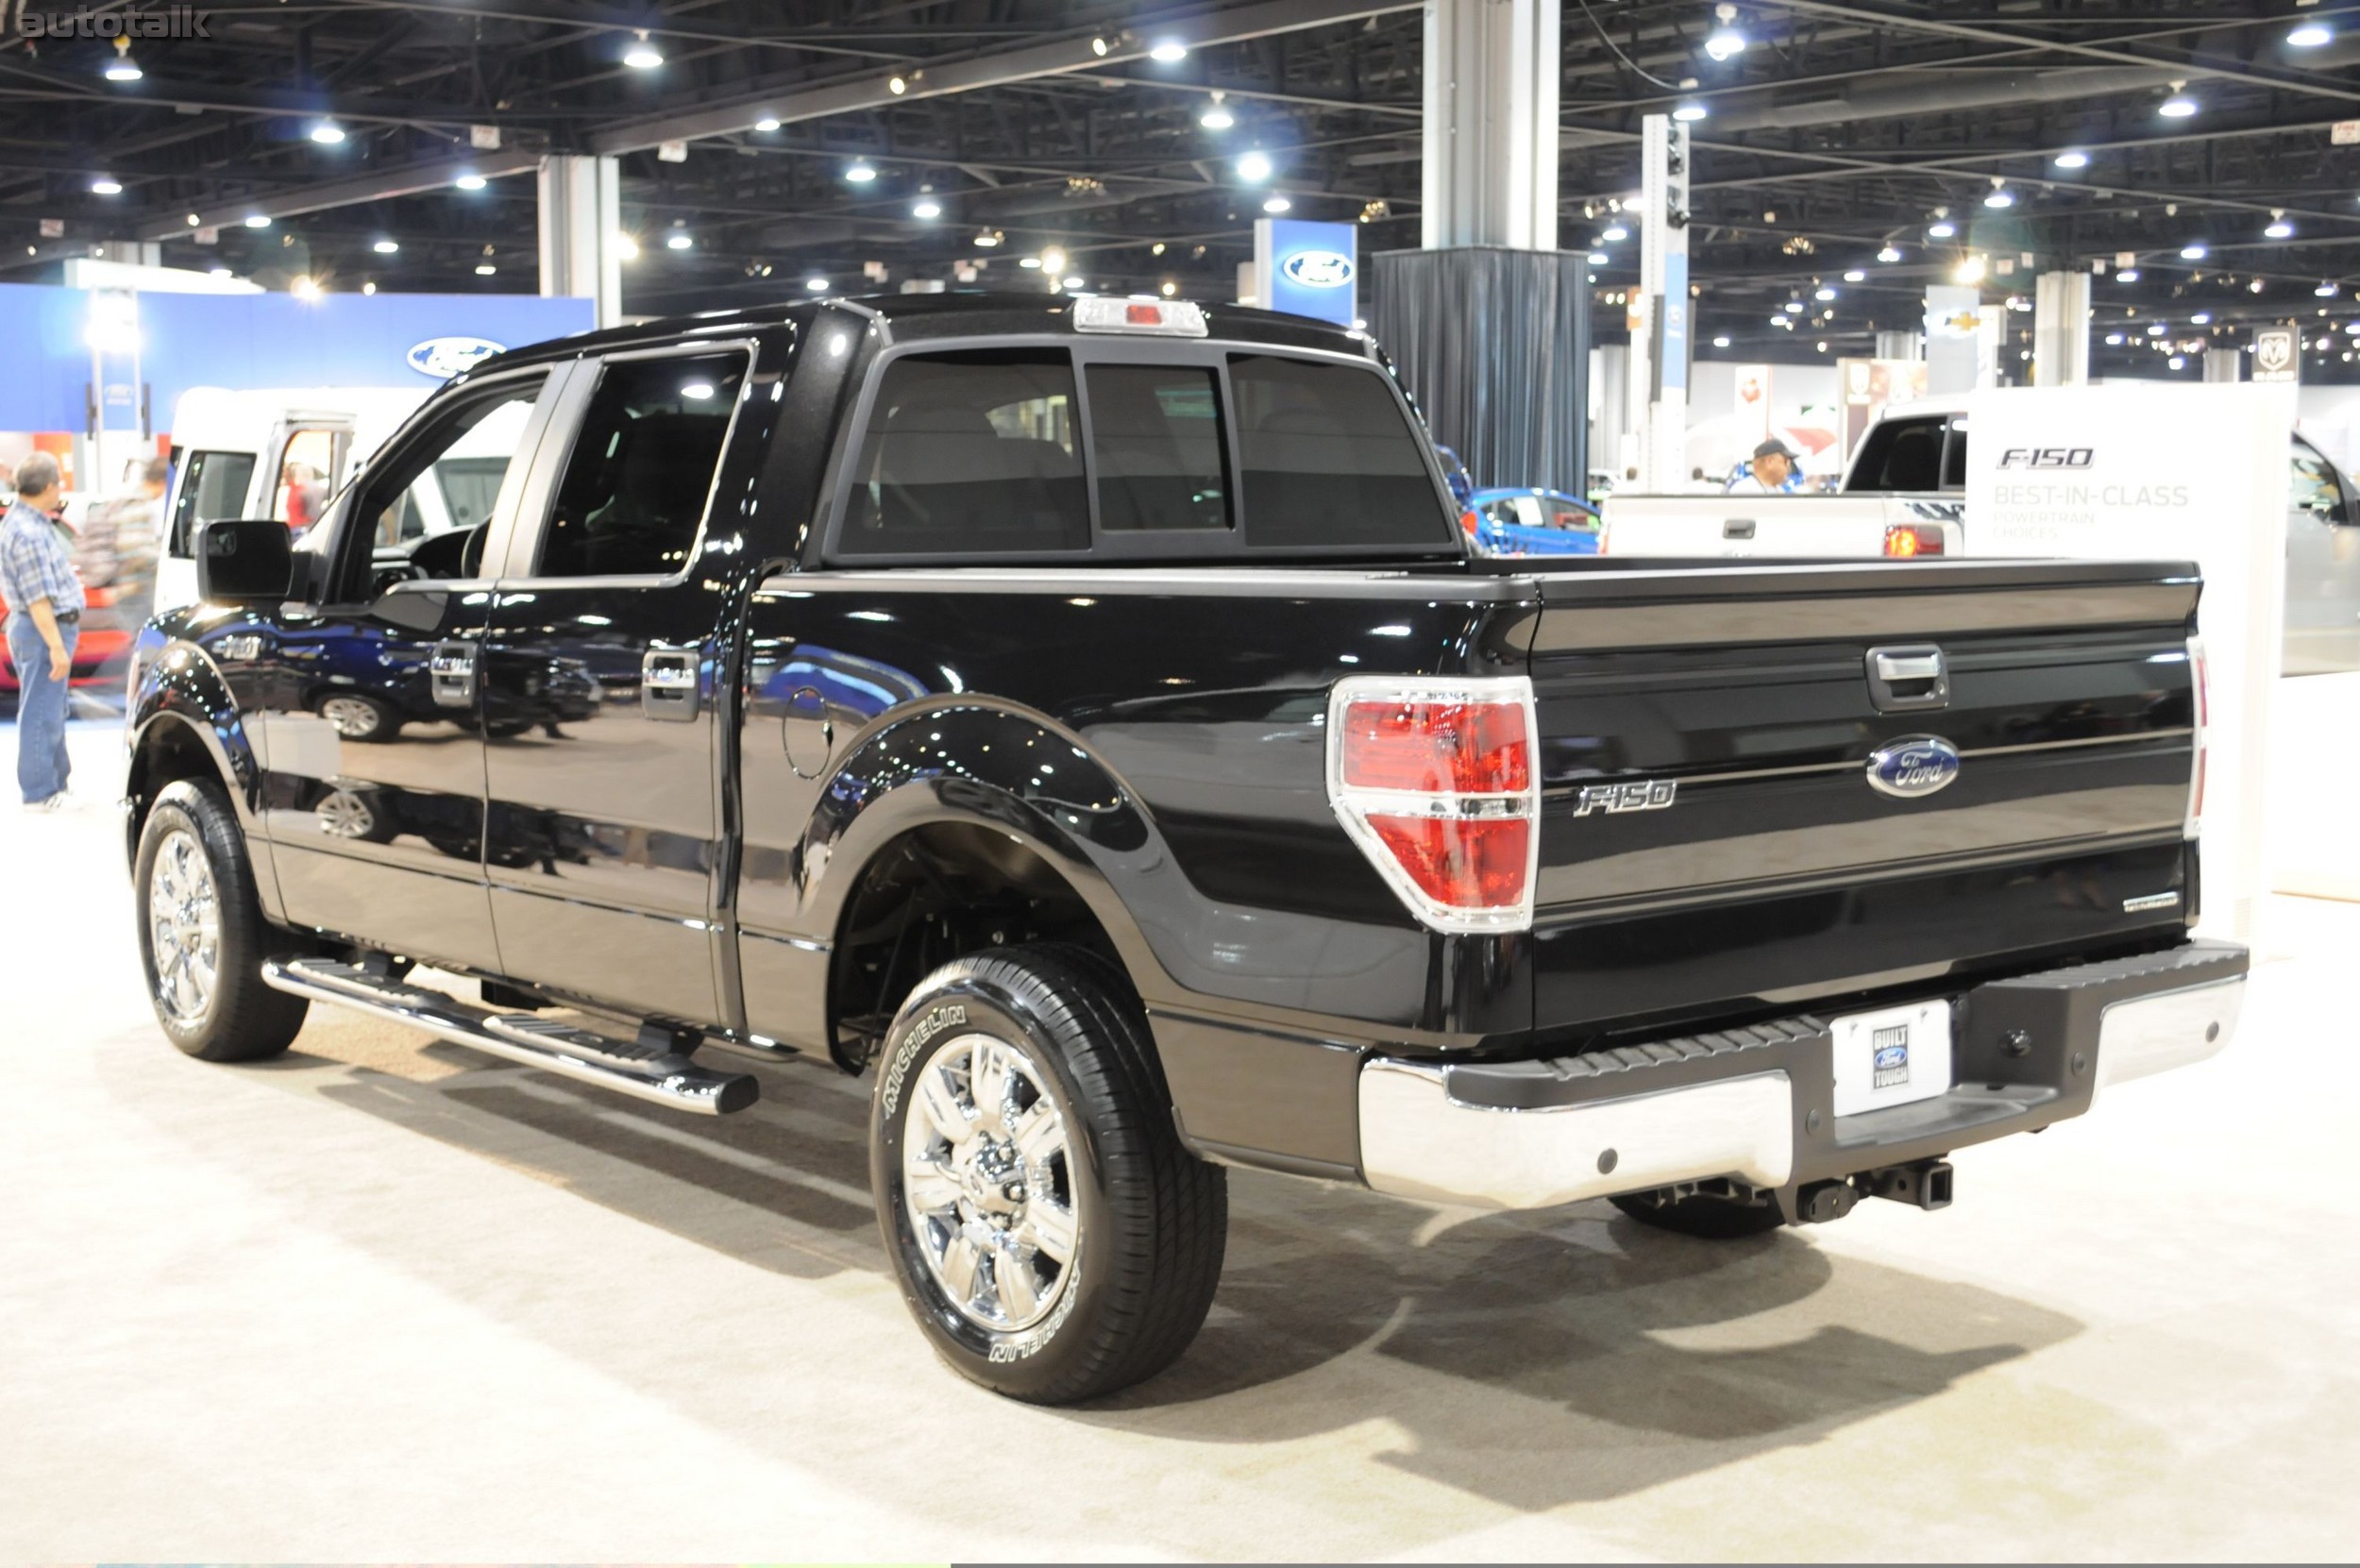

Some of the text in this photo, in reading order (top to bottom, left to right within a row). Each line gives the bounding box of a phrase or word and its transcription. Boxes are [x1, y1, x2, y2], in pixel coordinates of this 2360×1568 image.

[1996, 448, 2095, 469] F-150
[1994, 484, 2189, 507] BEST-IN-CLASS
[1993, 511, 2095, 525] POWERTRAIN
[1993, 527, 2058, 539] CHOICES
[1895, 750, 1945, 786] Ford
[1874, 1026, 1907, 1051] BUILT
[883, 1005, 967, 1121] MICHELIN
[1874, 1066, 1908, 1088] TOUGH
